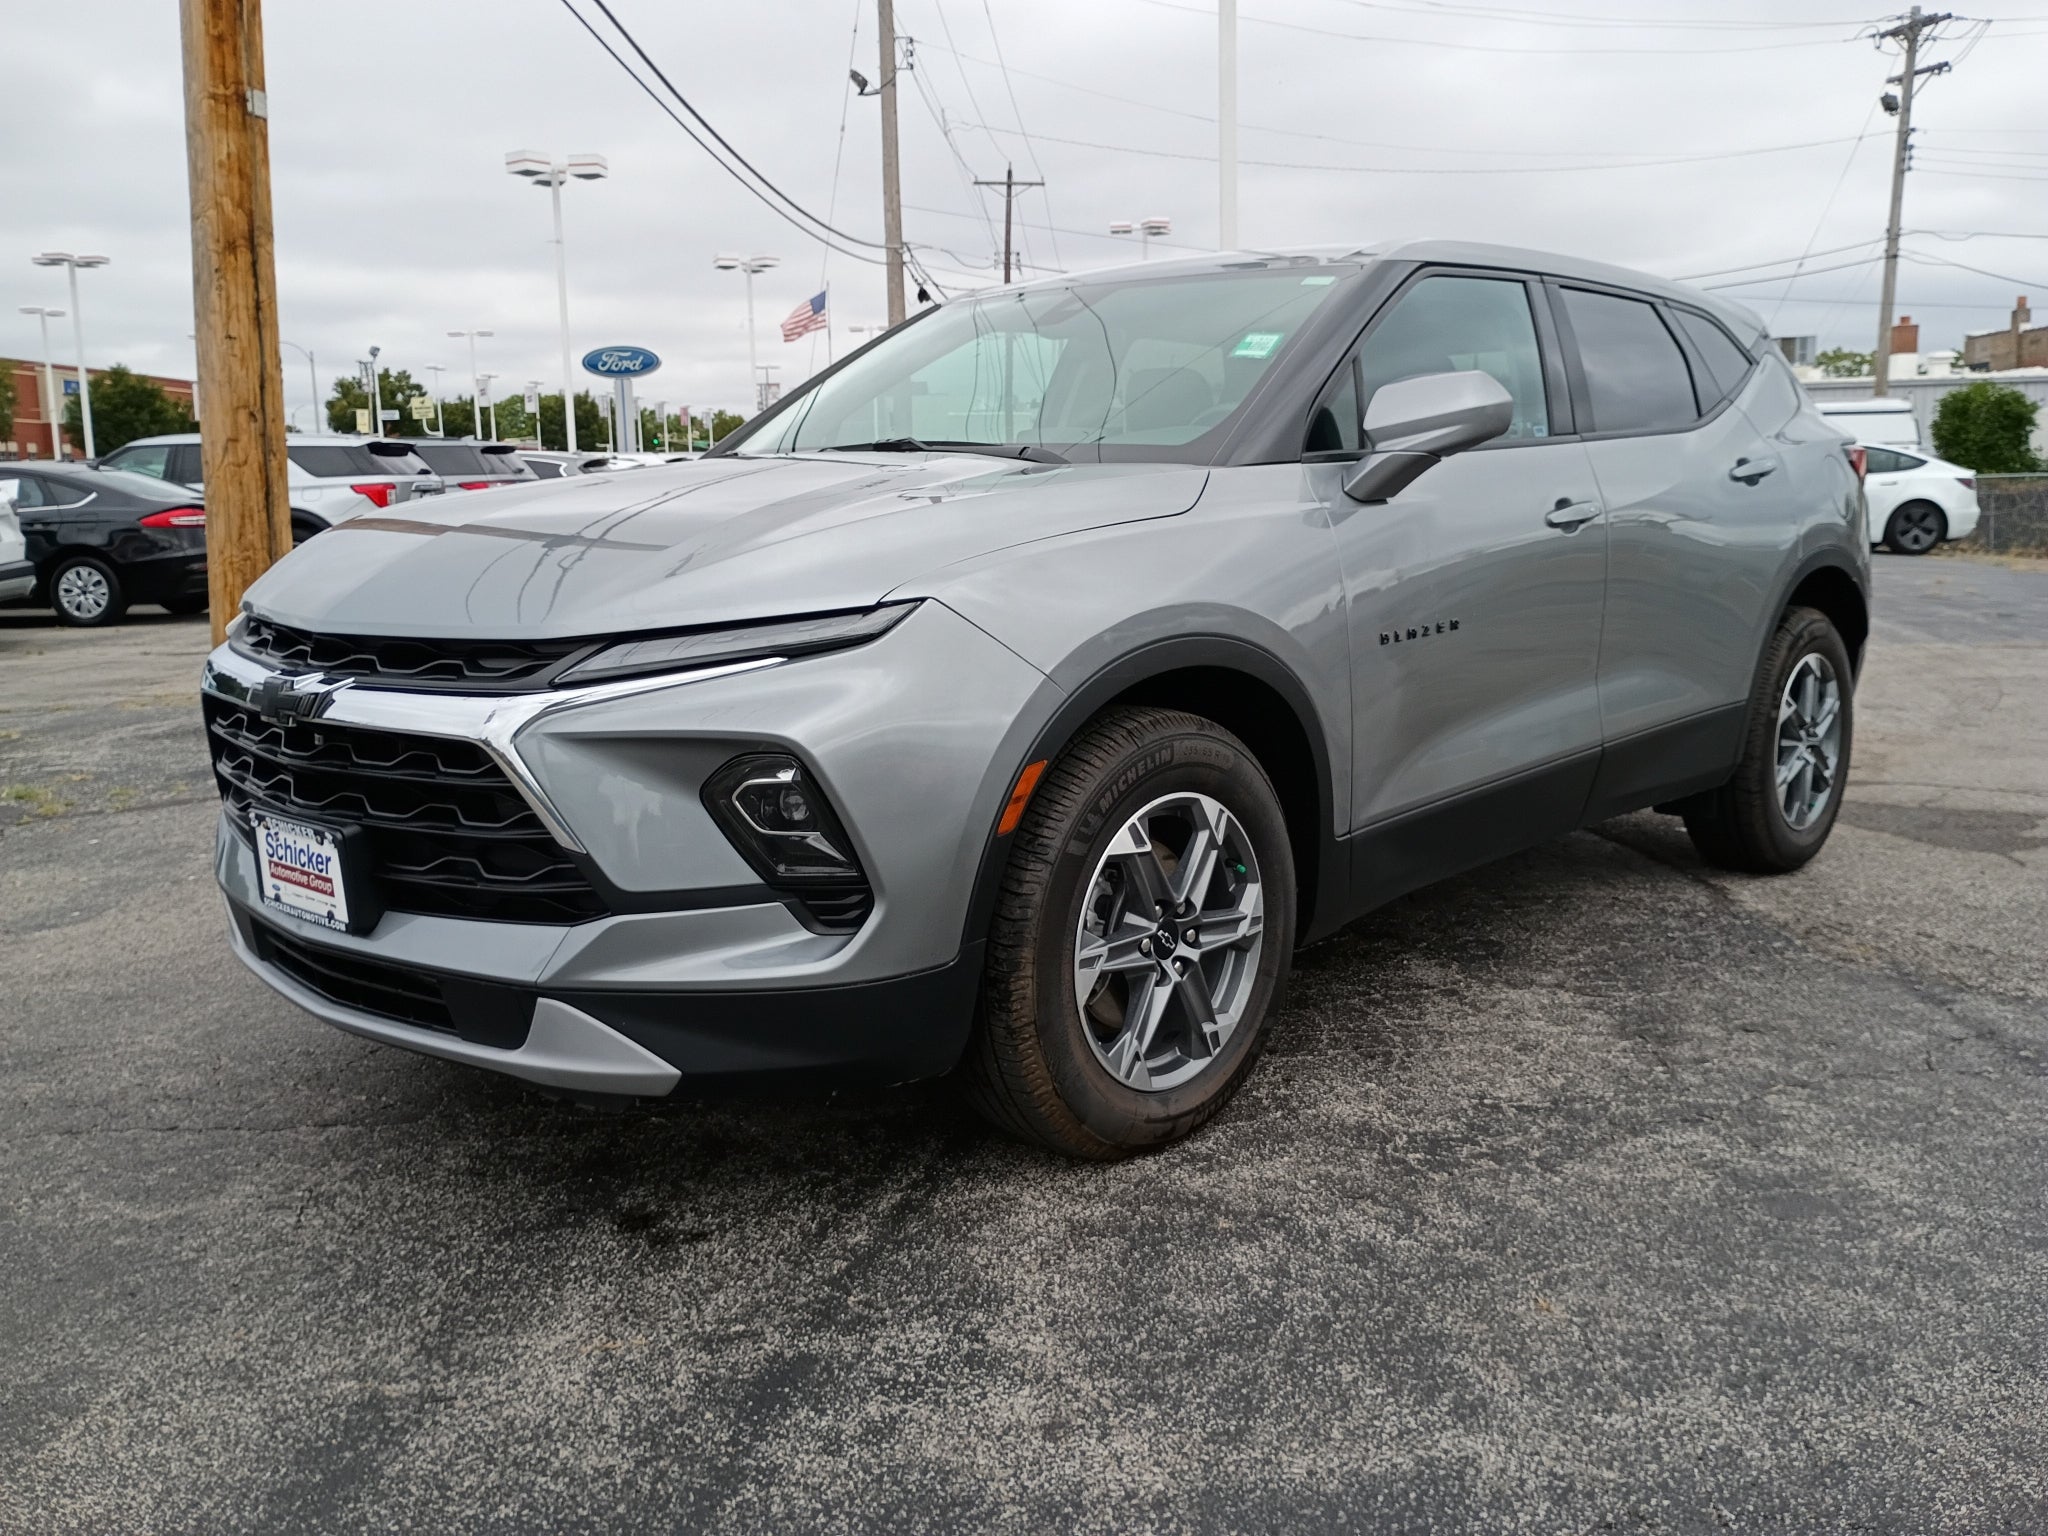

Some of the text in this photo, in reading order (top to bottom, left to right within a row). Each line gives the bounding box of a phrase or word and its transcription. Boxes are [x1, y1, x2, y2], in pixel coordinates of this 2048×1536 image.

[598, 351, 644, 372] Ford
[1379, 619, 1460, 646] BLAZER
[1100, 747, 1172, 814] MICHELIN
[265, 831, 332, 875] Schicker
[270, 863, 333, 894] Automotive Group
